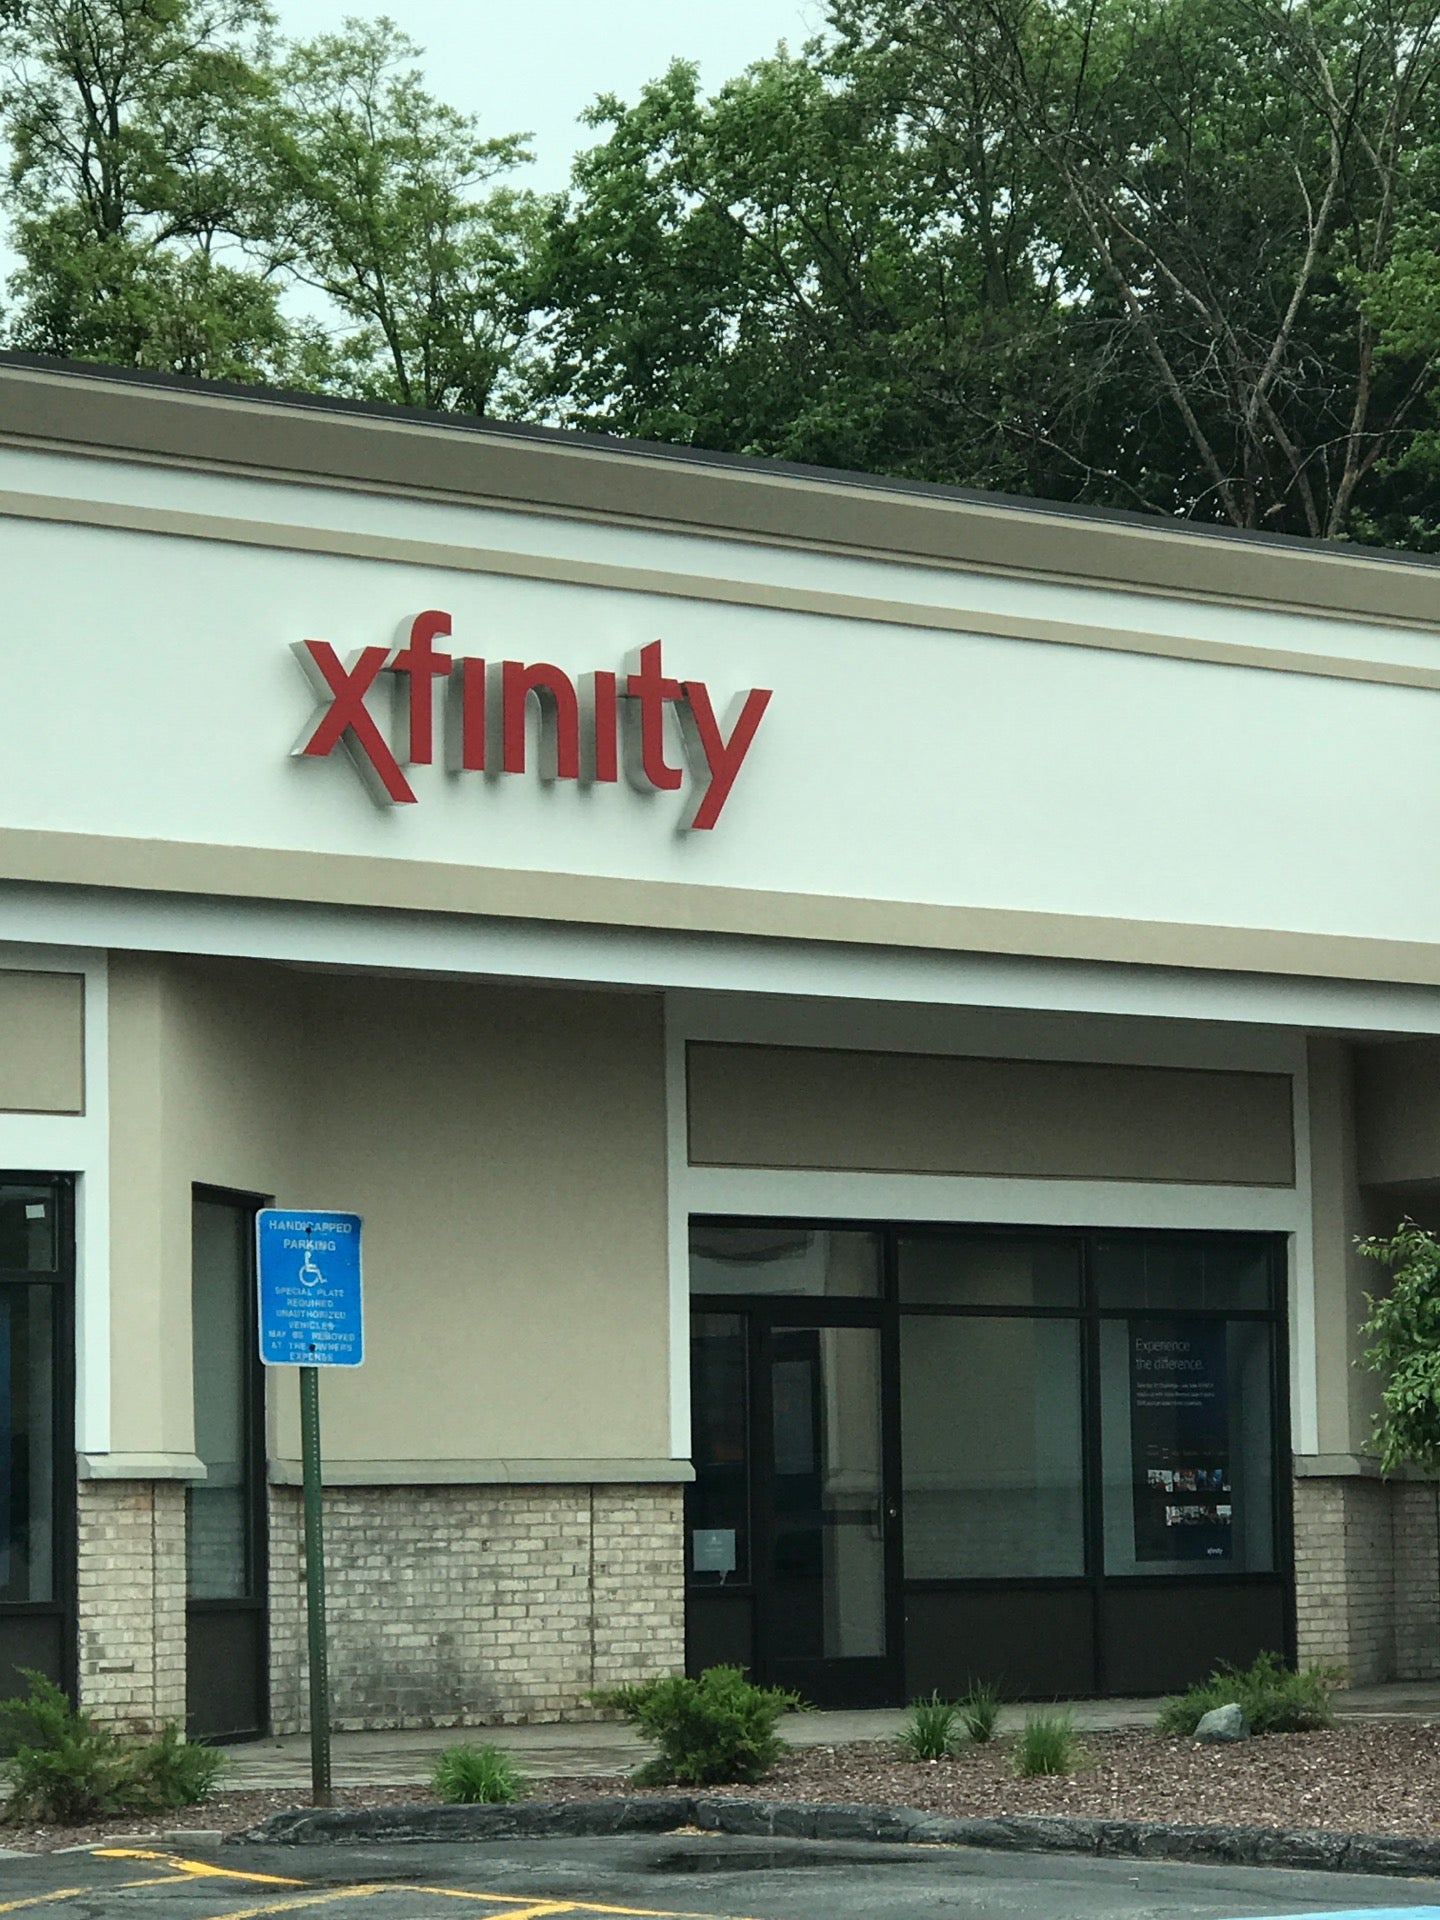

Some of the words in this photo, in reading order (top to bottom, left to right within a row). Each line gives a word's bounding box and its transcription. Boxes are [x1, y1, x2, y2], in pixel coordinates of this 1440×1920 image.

[299, 610, 774, 830] xfinity
[269, 1220, 352, 1233] HANDICAPPED
[283, 1238, 336, 1251] PARKING
[275, 1286, 312, 1296] SPECIAL
[317, 1288, 345, 1297] PLATE
[287, 1298, 334, 1308] REQUIRED
[275, 1309, 346, 1319] UNAUTHORIZED
[288, 1321, 335, 1330] VEHICLES
[311, 1332, 355, 1341] REMOVED
[271, 1341, 282, 1349] AT
[289, 1342, 306, 1350] THE
[1135, 1338, 1191, 1353] Experience
[289, 1352, 333, 1362] EXPENSE
[1135, 1357, 1152, 1370] the
